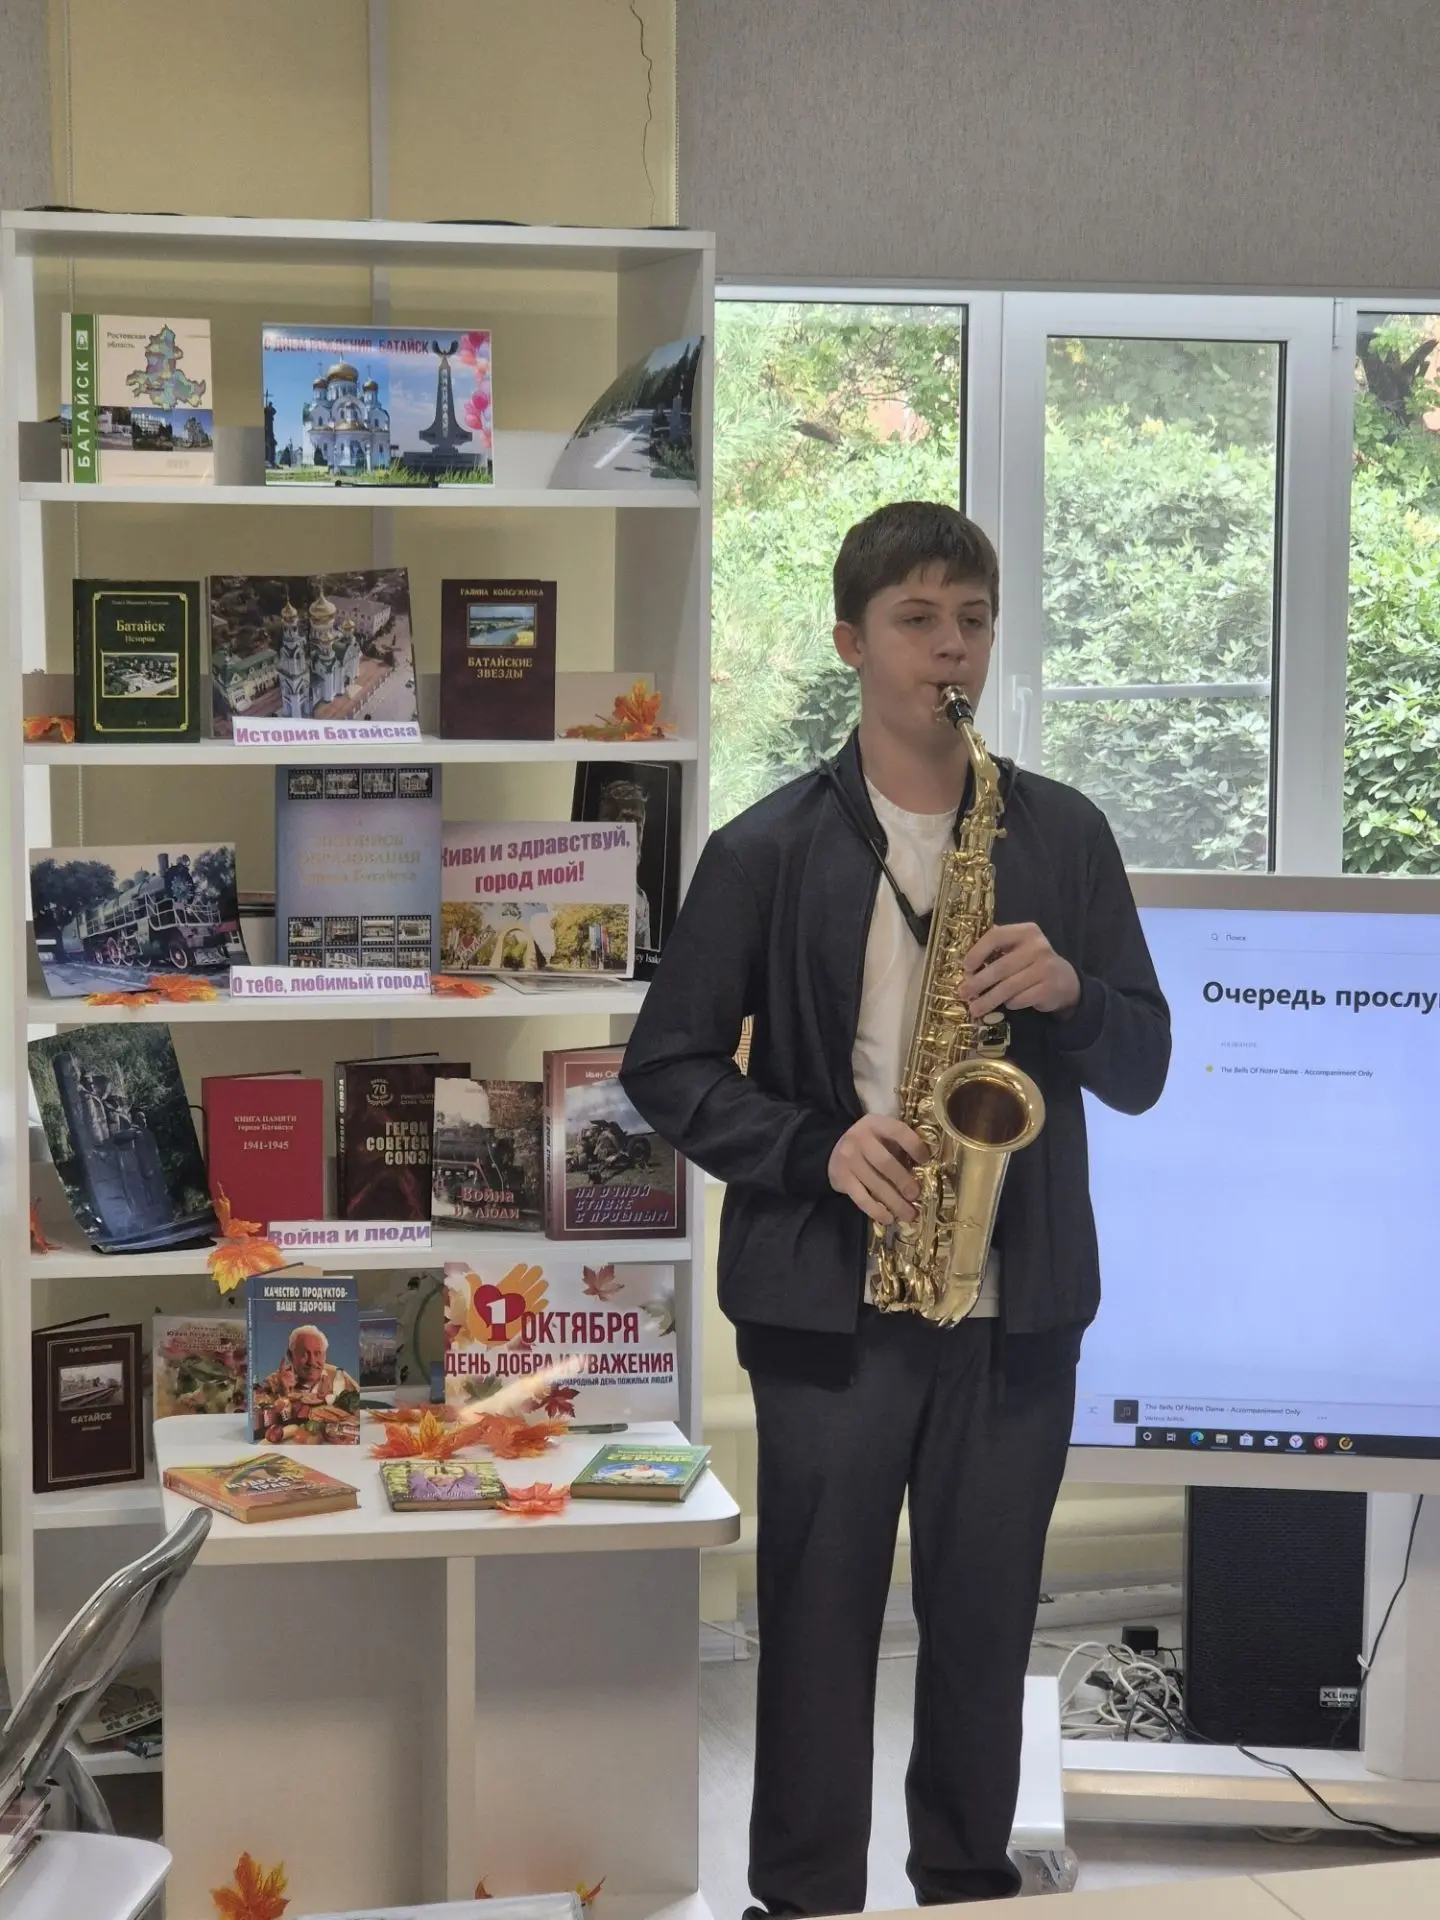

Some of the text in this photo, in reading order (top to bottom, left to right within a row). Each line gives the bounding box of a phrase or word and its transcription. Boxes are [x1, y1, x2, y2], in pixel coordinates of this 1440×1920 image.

[378, 338, 429, 354] БАТАЙСК
[75, 360, 90, 468] БАТАЙСК
[460, 588, 489, 596] ГАЛИНА
[116, 620, 166, 632] Батайск
[125, 635, 156, 644] История
[468, 655, 533, 668] БАТАЙСКИЕ
[477, 669, 523, 679] ЗВЕЗДЫ
[236, 725, 418, 743] История Батайска
[490, 844, 503, 861] и
[507, 825, 631, 862] здравствуй,
[475, 861, 585, 893] город мой!
[1226, 934, 1246, 942] Поиск
[232, 972, 430, 994] О тебе, любимый город!
[1202, 981, 1440, 1015] Очередь прослу
[1304, 1069, 1356, 1077] Accompaniment
[1358, 1070, 1373, 1078] Only
[372, 1084, 386, 1095] 70
[234, 1115, 297, 1123] КНИГА ПАМЯТИ
[243, 1140, 289, 1150] 1941-1945
[269, 1225, 431, 1246] Война и люди
[264, 1286, 348, 1299] КАЧЕСТВО ПРОДУКТОВ-
[276, 1301, 336, 1313] ВАШЕ ЗДОРОВЬЕ
[486, 1298, 639, 1344] 1 ОКТЯБРЯ
[445, 1353, 491, 1377] ДЕНЬ
[496, 1353, 554, 1377] ДОБРА
[576, 1352, 674, 1375] УВАЖЕНИЯ
[600, 1377, 617, 1386] ДЕНЬ
[71, 1412, 112, 1424] БАТАЙСК
[1285, 1408, 1301, 1416] Only
